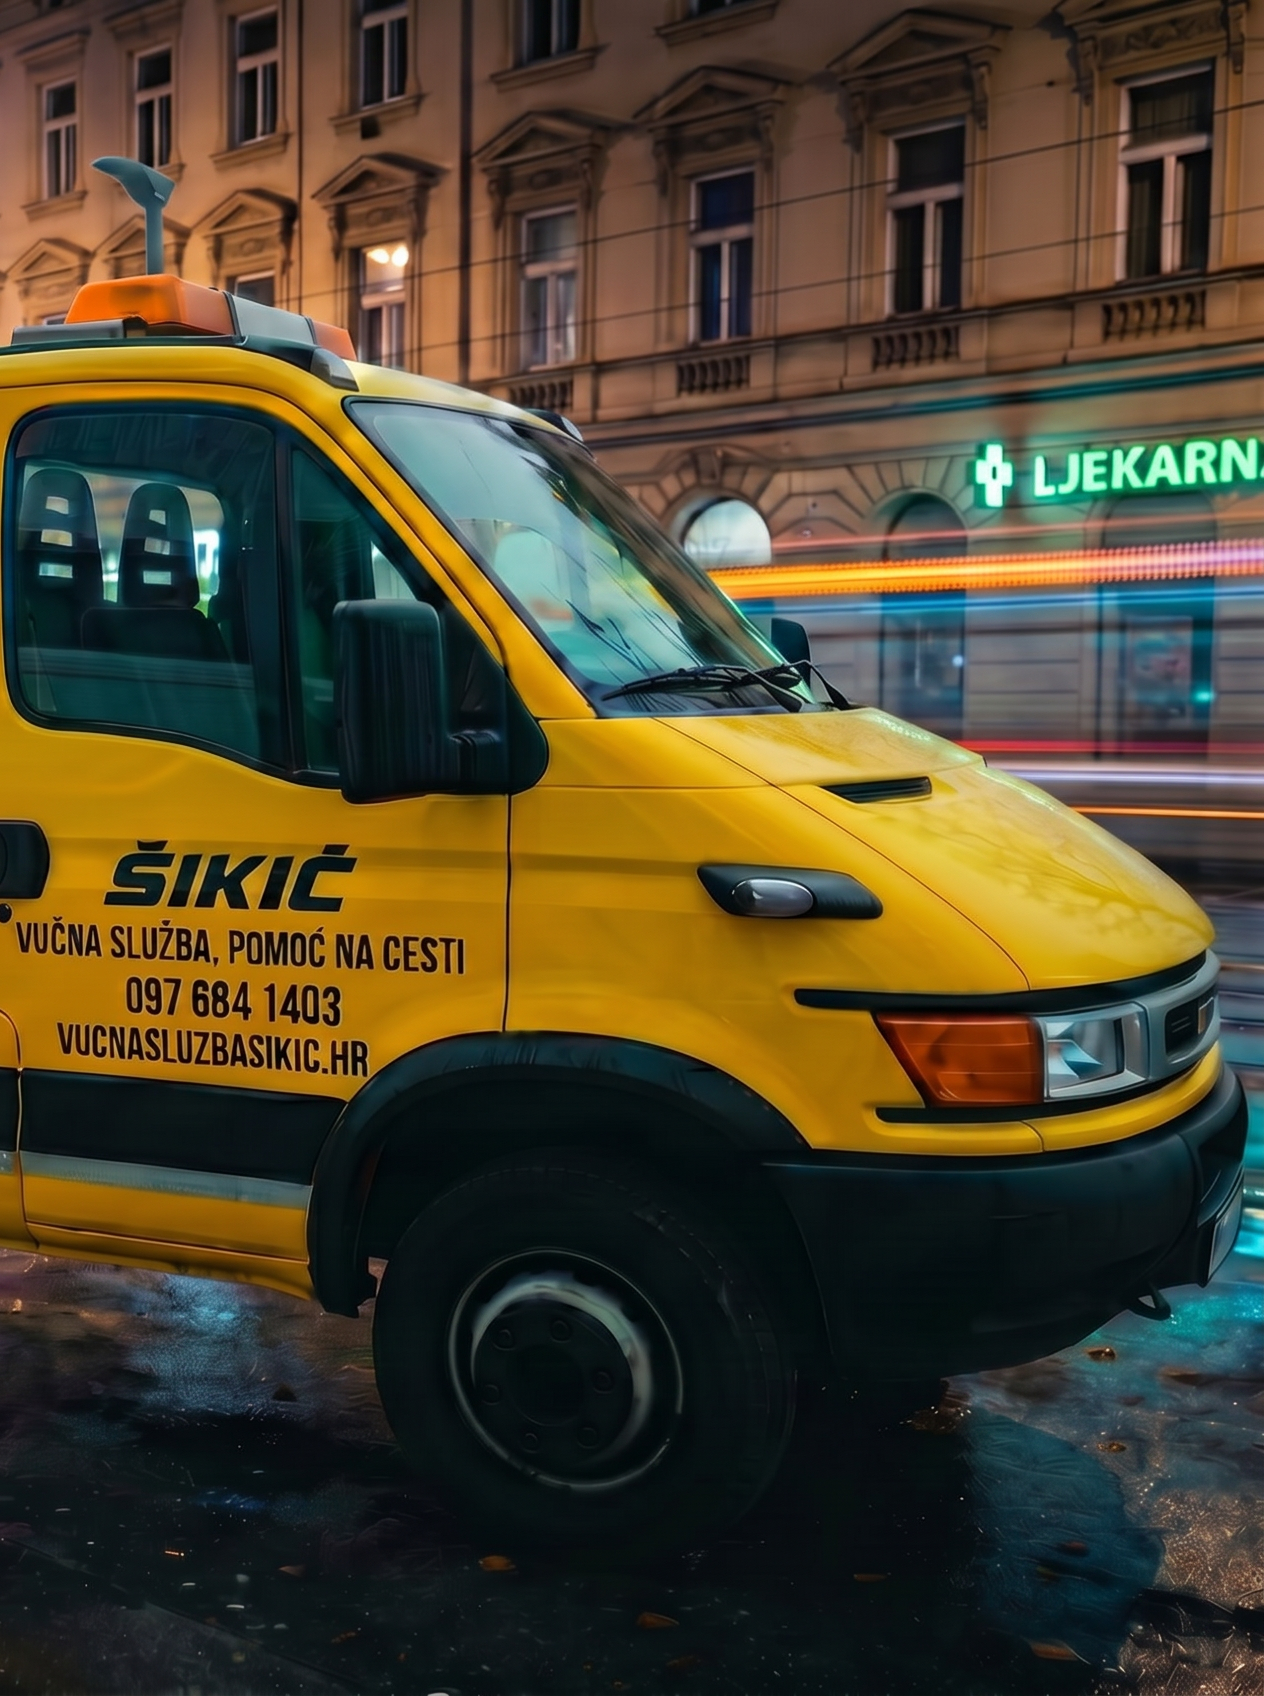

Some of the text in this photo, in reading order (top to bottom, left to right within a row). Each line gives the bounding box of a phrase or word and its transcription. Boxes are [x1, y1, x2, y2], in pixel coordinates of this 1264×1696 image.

[1034, 438, 1264, 497] LJEKARN
[16, 916, 464, 974] VUČNA SLUŽBA, POMOĆ NA CESTI
[126, 977, 340, 1026] 097 684 1403
[57, 1022, 368, 1077] VUCNASLUZBASIKIC.HR
